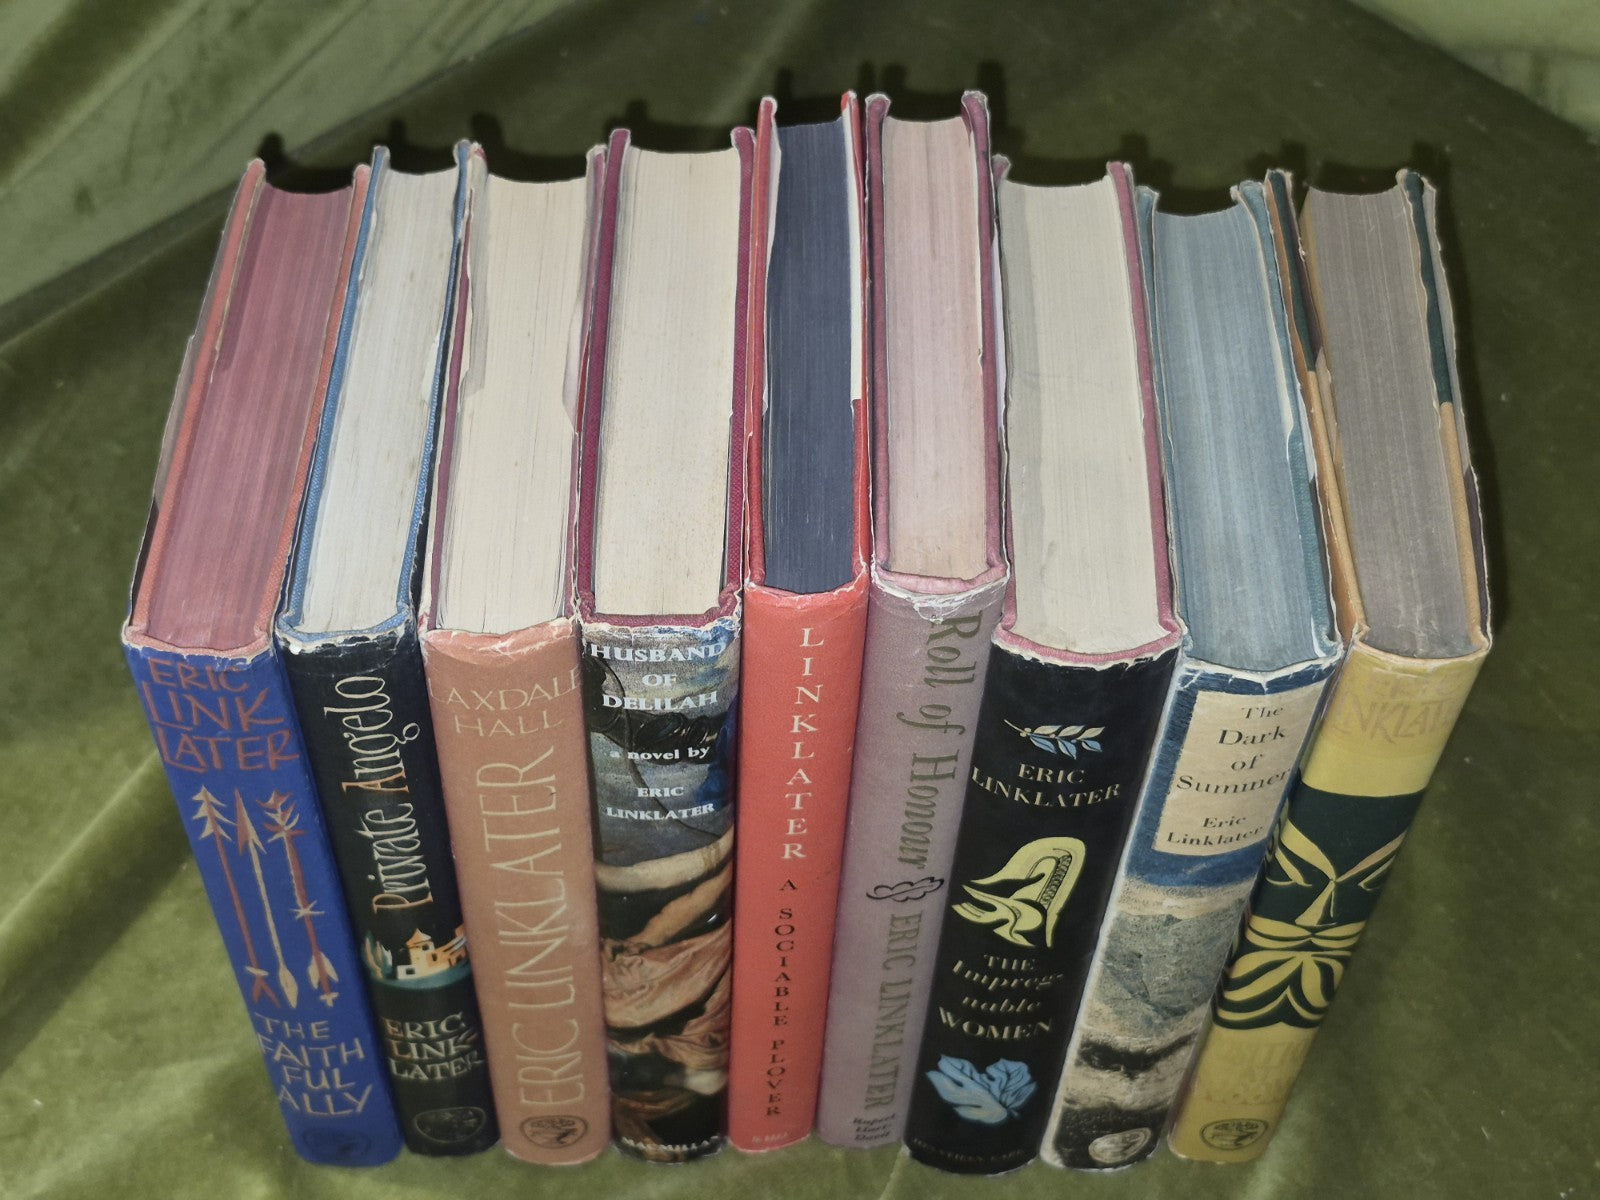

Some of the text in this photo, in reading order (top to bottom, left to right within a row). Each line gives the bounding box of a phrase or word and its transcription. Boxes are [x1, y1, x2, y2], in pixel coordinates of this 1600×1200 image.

[590, 643, 726, 661] HUSBAND
[148, 657, 249, 692] ERIC
[642, 674, 678, 687] OF
[142, 680, 285, 732] LINK
[602, 691, 718, 711] DELILAH
[1242, 706, 1284, 719] The
[454, 710, 565, 737] HALL
[1218, 726, 1286, 746] Dark
[157, 728, 300, 773] LATER
[782, 627, 824, 859] LINKLATER
[897, 610, 983, 869] Roll of Honour
[609, 747, 710, 760] a novel by
[1231, 753, 1264, 772] of
[972, 766, 1121, 808] LINKLATER
[1018, 763, 1086, 785] ERIC
[1176, 768, 1291, 794] Summer
[324, 676, 433, 914] Private Angelo
[637, 786, 685, 798] ERIC
[606, 803, 715, 820] LINKLATER
[1203, 815, 1247, 828] Eric
[1166, 826, 1264, 846] Linklater
[779, 879, 797, 891] A
[476, 744, 585, 1106] ERIC LINKLATER
[772, 908, 796, 1027] SOCIABLE
[984, 954, 1035, 970] THE
[864, 910, 923, 1111] ERIC LINKLATER
[962, 996, 1041, 1012] nable
[255, 1012, 329, 1039] THE
[382, 1011, 466, 1039] ERIC
[939, 1006, 1052, 1039] WOMEN
[257, 1033, 366, 1068] FAITH
[282, 1065, 357, 1091] FUL
[388, 1049, 484, 1080] LATER
[765, 1040, 786, 1116] PLOVER
[279, 1084, 374, 1115] ALLY
